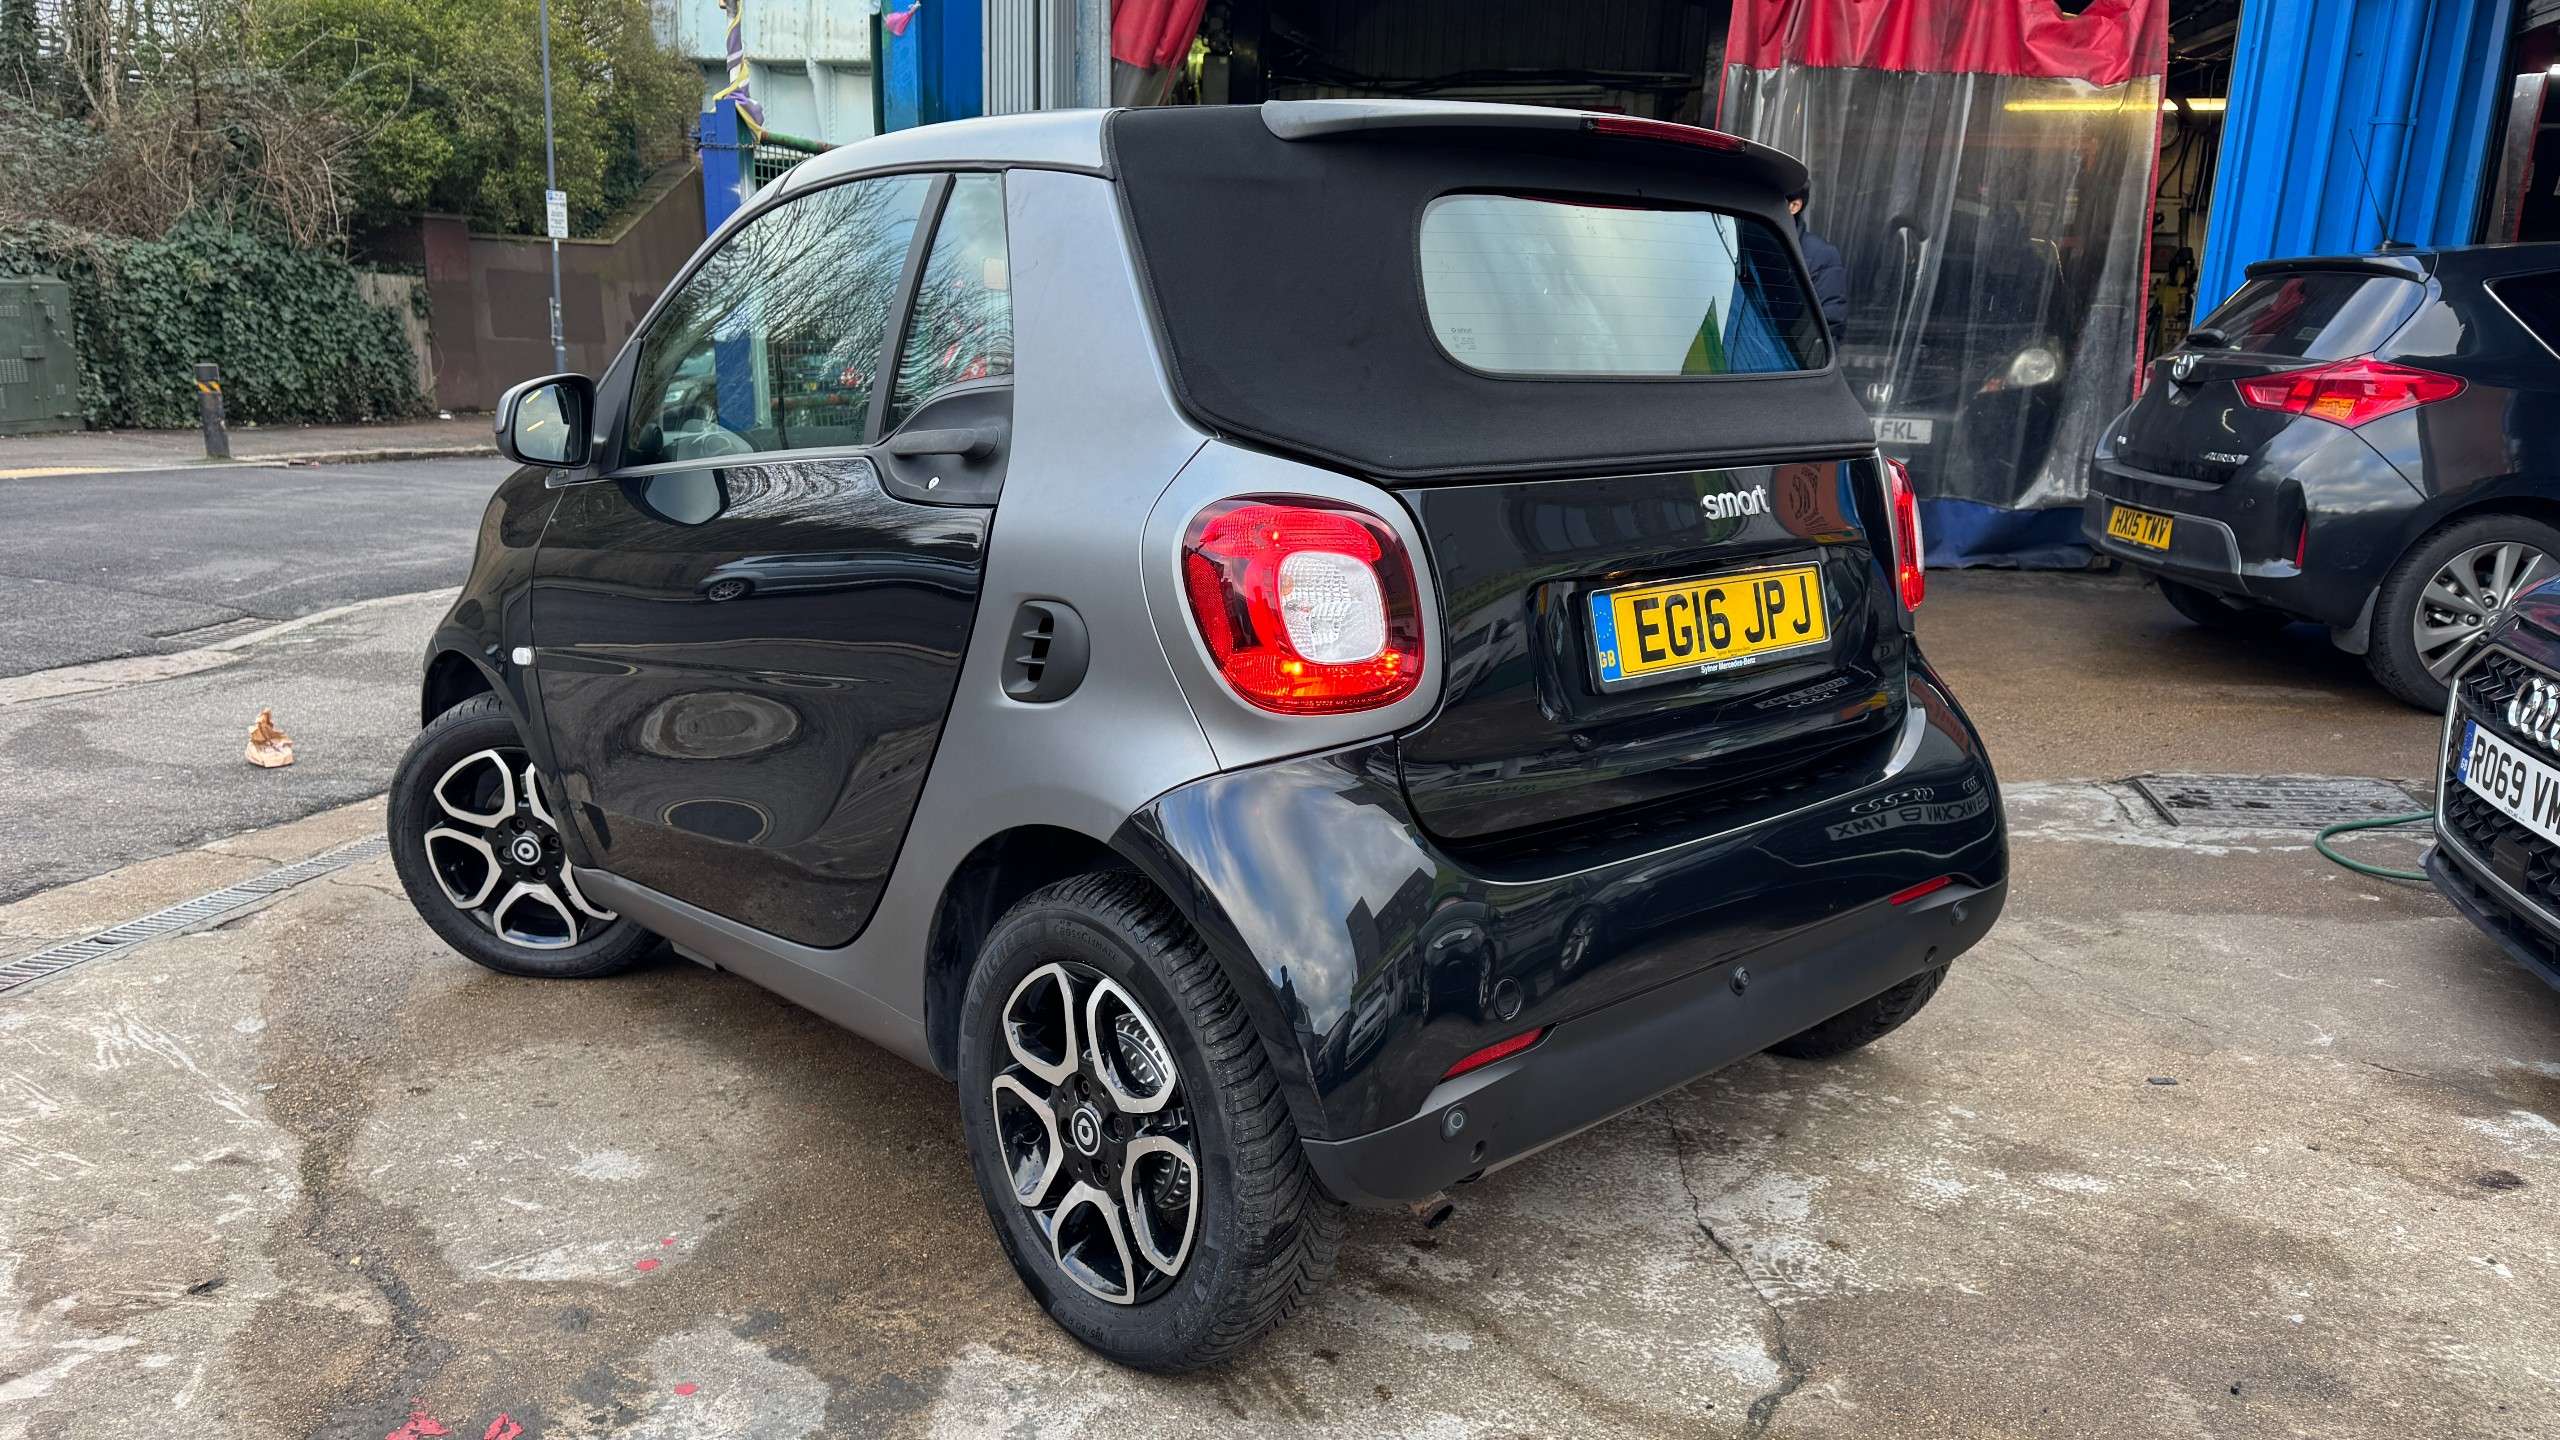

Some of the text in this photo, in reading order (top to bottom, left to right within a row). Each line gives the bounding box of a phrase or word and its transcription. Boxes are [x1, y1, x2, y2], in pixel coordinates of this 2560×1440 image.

[1702, 484, 1771, 520] smart
[2113, 508, 2170, 543] HX15 TWV
[1633, 576, 1811, 663] EG16 JPJ
[1600, 651, 1616, 668] GB
[2469, 734, 2527, 810] RO69
